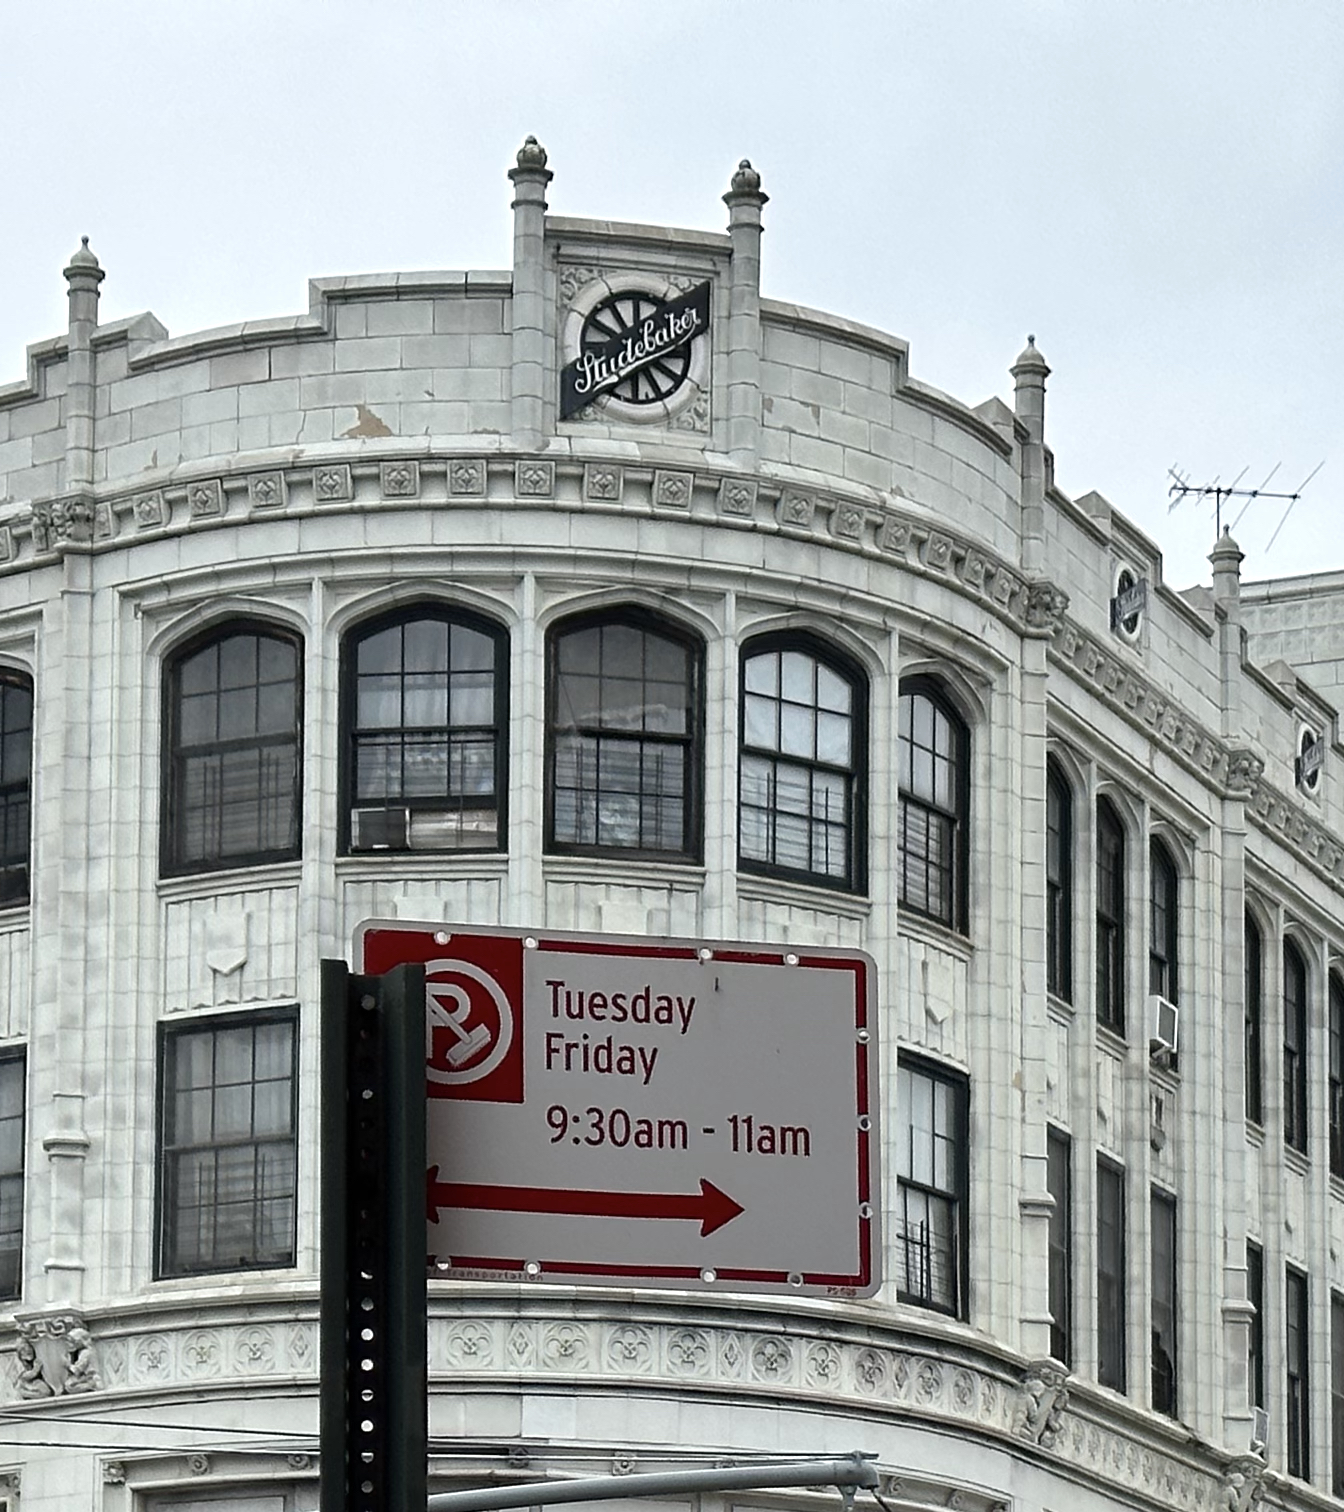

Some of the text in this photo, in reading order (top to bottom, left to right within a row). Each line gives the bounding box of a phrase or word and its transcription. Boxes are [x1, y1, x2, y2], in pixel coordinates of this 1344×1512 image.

[575, 306, 702, 394] Studebaker
[545, 979, 695, 1035] Tuesday
[544, 1032, 658, 1085] Friday
[546, 1104, 810, 1157] 9:30am - 11am
